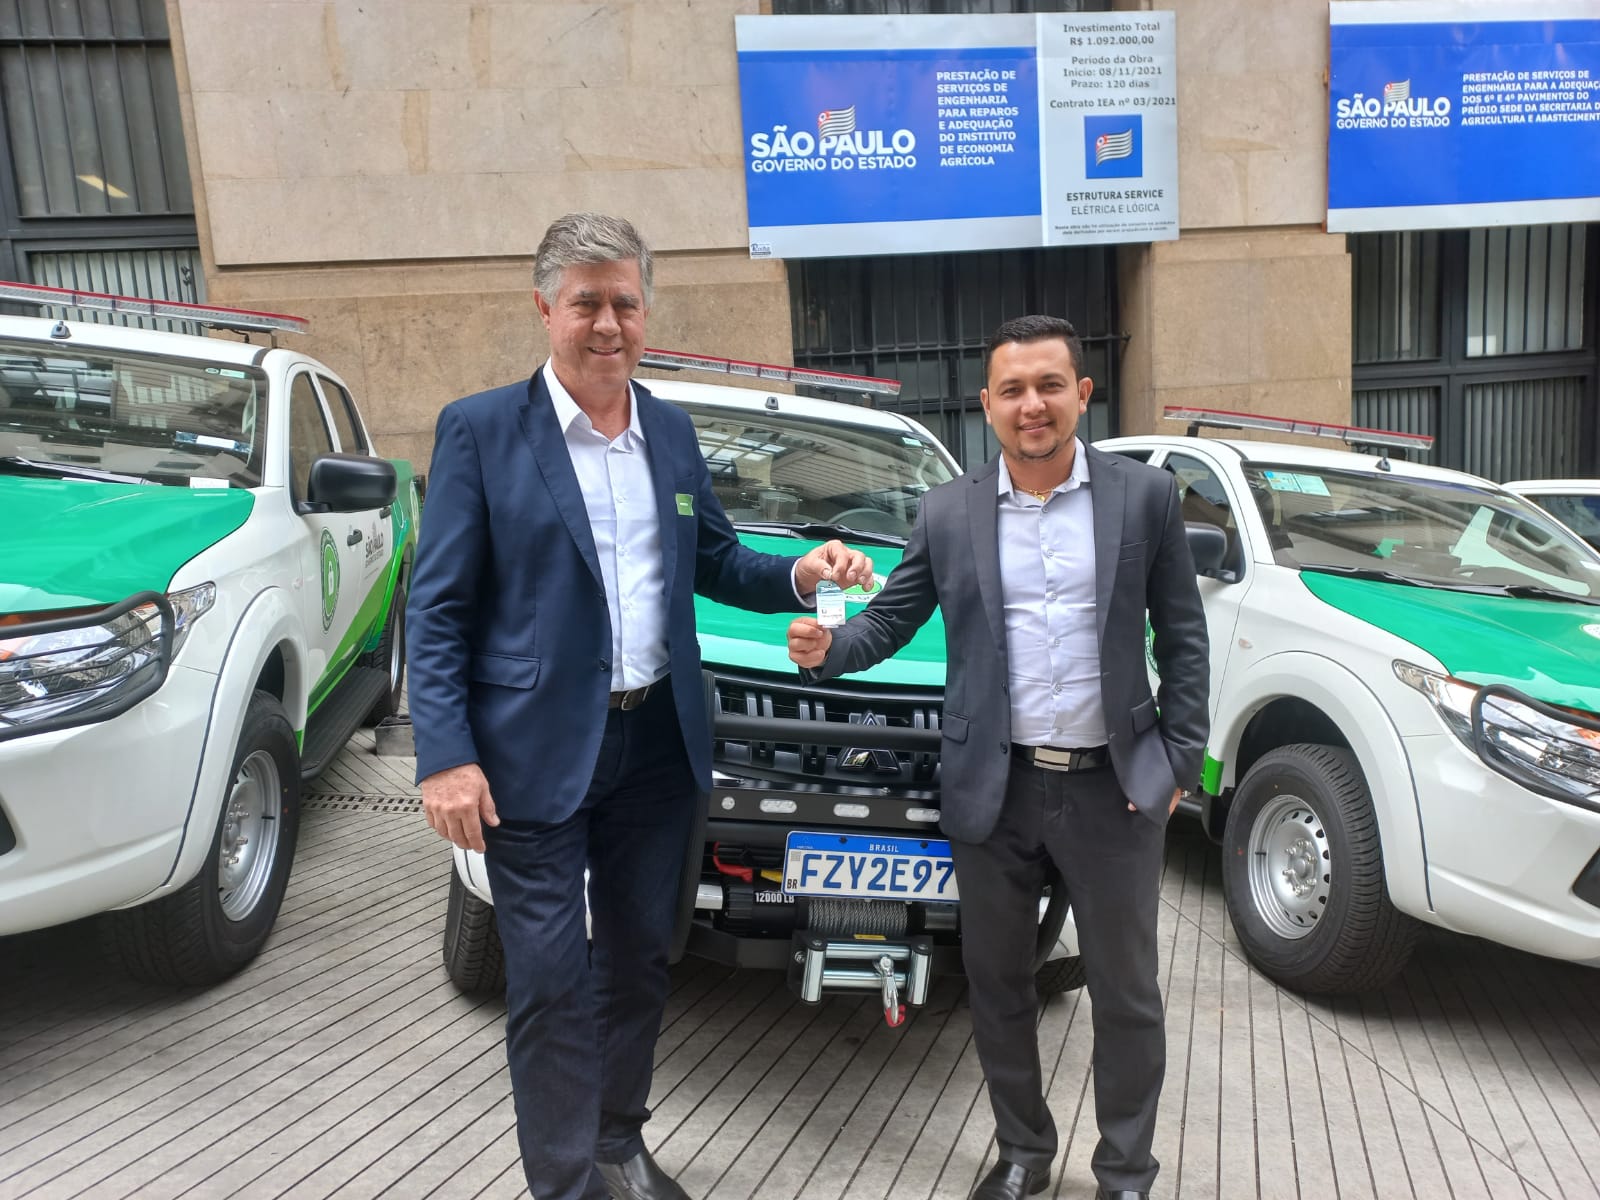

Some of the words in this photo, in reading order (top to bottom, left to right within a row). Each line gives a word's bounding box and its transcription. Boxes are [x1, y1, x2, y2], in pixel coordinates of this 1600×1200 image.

[1063, 23, 1132, 33] Investimento
[1135, 22, 1161, 31] Total
[1070, 37, 1083, 46] R$
[1088, 35, 1154, 46] 1.092.000,00
[1113, 55, 1126, 64] da
[1129, 54, 1153, 63] Obra
[936, 68, 999, 82] PRESTAÇÃO
[1001, 70, 1017, 80] DE
[1099, 66, 1162, 77] 08/11/2021
[1462, 71, 1515, 82] PRESTAÇÃO
[1518, 71, 1530, 80] DE
[1532, 70, 1576, 80] SERVIÇOS
[1578, 70, 1590, 79] DE
[937, 83, 991, 95] SERVIÇOS
[993, 82, 1008, 92] DE
[1071, 79, 1103, 88] Prazo:
[1107, 80, 1126, 88] 120
[1129, 79, 1150, 88] dias
[1462, 83, 1522, 93] ENGENHARIA
[1524, 82, 1548, 91] PARA
[1550, 81, 1557, 90] A
[1559, 81, 1600, 91] ADEQUAÇ
[937, 95, 1008, 105] ENGENHARIA
[1050, 99, 1094, 109] Contrato
[1097, 98, 1115, 107] IEA
[1118, 97, 1130, 106] nº
[1133, 97, 1176, 107] 03/2021
[1462, 95, 1482, 104] DOS
[1484, 95, 1495, 103] 6º
[1497, 94, 1502, 102] E
[1505, 93, 1515, 102] 4º
[1517, 92, 1574, 102] PAVIMENTOS
[1577, 91, 1589, 100] DO
[938, 108, 967, 118] PARA
[969, 106, 1019, 117] REPAROS
[1336, 93, 1381, 119] SÃO
[1383, 96, 1451, 117] PAULO
[1462, 103, 1498, 115] PRÉDIO
[1500, 104, 1522, 113] SEDE
[1525, 103, 1537, 112] DA
[1540, 102, 1592, 112] SECRETARIA
[938, 120, 946, 130] E
[948, 117, 1014, 131] ADEQUAÇÃO
[1336, 118, 1388, 129] GOVERNO
[1391, 117, 1407, 128] DO
[1409, 116, 1450, 127] ESTADO
[1461, 115, 1525, 126] AGRICULTURA
[1528, 114, 1533, 123] E
[750, 124, 815, 158] SÃO
[818, 128, 916, 156] PAULO
[939, 133, 955, 142] DO
[958, 131, 1017, 141] INSTITUTO
[939, 145, 954, 154] DE
[957, 143, 1015, 154] ECONOMIA
[751, 157, 827, 173] GOVERNO
[830, 156, 854, 171] DO
[858, 155, 917, 170] ESTADO
[940, 153, 995, 167] AGRÍCOLA
[1066, 191, 1122, 201] ESTRUTURA
[1125, 189, 1164, 199] SERVICE
[1071, 203, 1116, 215] ELÉTRICA
[1118, 204, 1124, 214] E
[1126, 202, 1160, 213] LÓGICA
[868, 843, 899, 853] BRASIL
[800, 853, 955, 894] FZY2E97
[786, 878, 798, 890] BR
[755, 891, 783, 904] 12000
